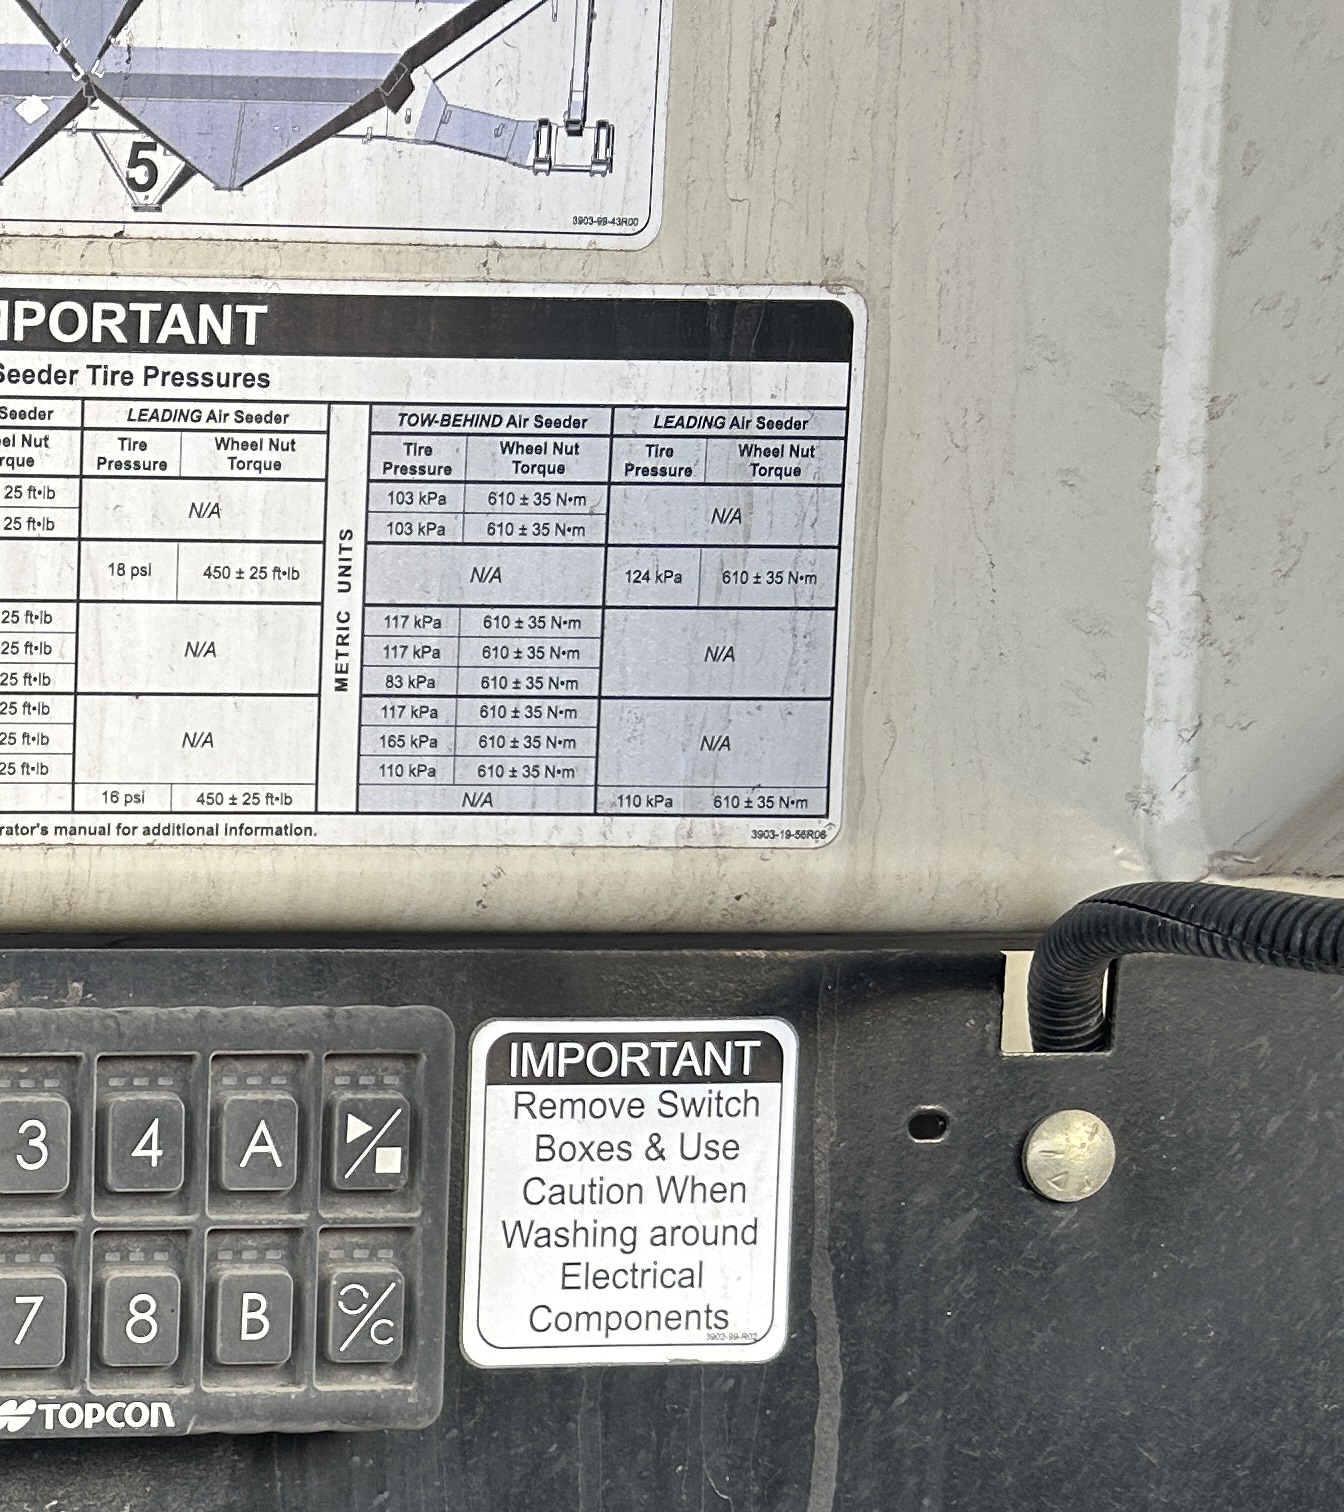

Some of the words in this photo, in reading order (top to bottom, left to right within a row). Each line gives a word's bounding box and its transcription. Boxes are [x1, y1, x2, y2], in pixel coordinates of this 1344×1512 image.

[126, 141, 158, 192] 5
[86, 364, 134, 386] Tire
[143, 365, 270, 389] Pressures
[337, 528, 354, 594] UNITS
[469, 564, 502, 585] N/A
[625, 569, 651, 584] 124
[655, 569, 682, 584] kPa
[722, 570, 749, 585] 610
[766, 570, 785, 585] 35
[334, 609, 351, 693] METRIC
[54, 822, 111, 836] manual
[115, 822, 139, 836] for
[142, 823, 219, 837] additional
[224, 823, 317, 837] information.
[510, 1040, 761, 1078] IMPORTANT
[514, 1091, 645, 1119] Remove
[657, 1089, 759, 1119] Switch
[16, 1119, 49, 1171] 3
[131, 1118, 163, 1167] 4
[240, 1119, 283, 1168] A
[535, 1134, 632, 1162] Boxes
[644, 1132, 667, 1162] &
[680, 1132, 740, 1161] Use
[523, 1176, 643, 1206] Caution
[655, 1175, 746, 1204] When
[501, 1218, 637, 1255] Washing
[650, 1217, 758, 1247] around
[561, 1260, 703, 1290] Electrical
[15, 1296, 44, 1345] 7
[125, 1294, 158, 1344] 8
[241, 1291, 271, 1341] B
[529, 1303, 729, 1338] Components
[36, 1400, 176, 1430] TOPCON
